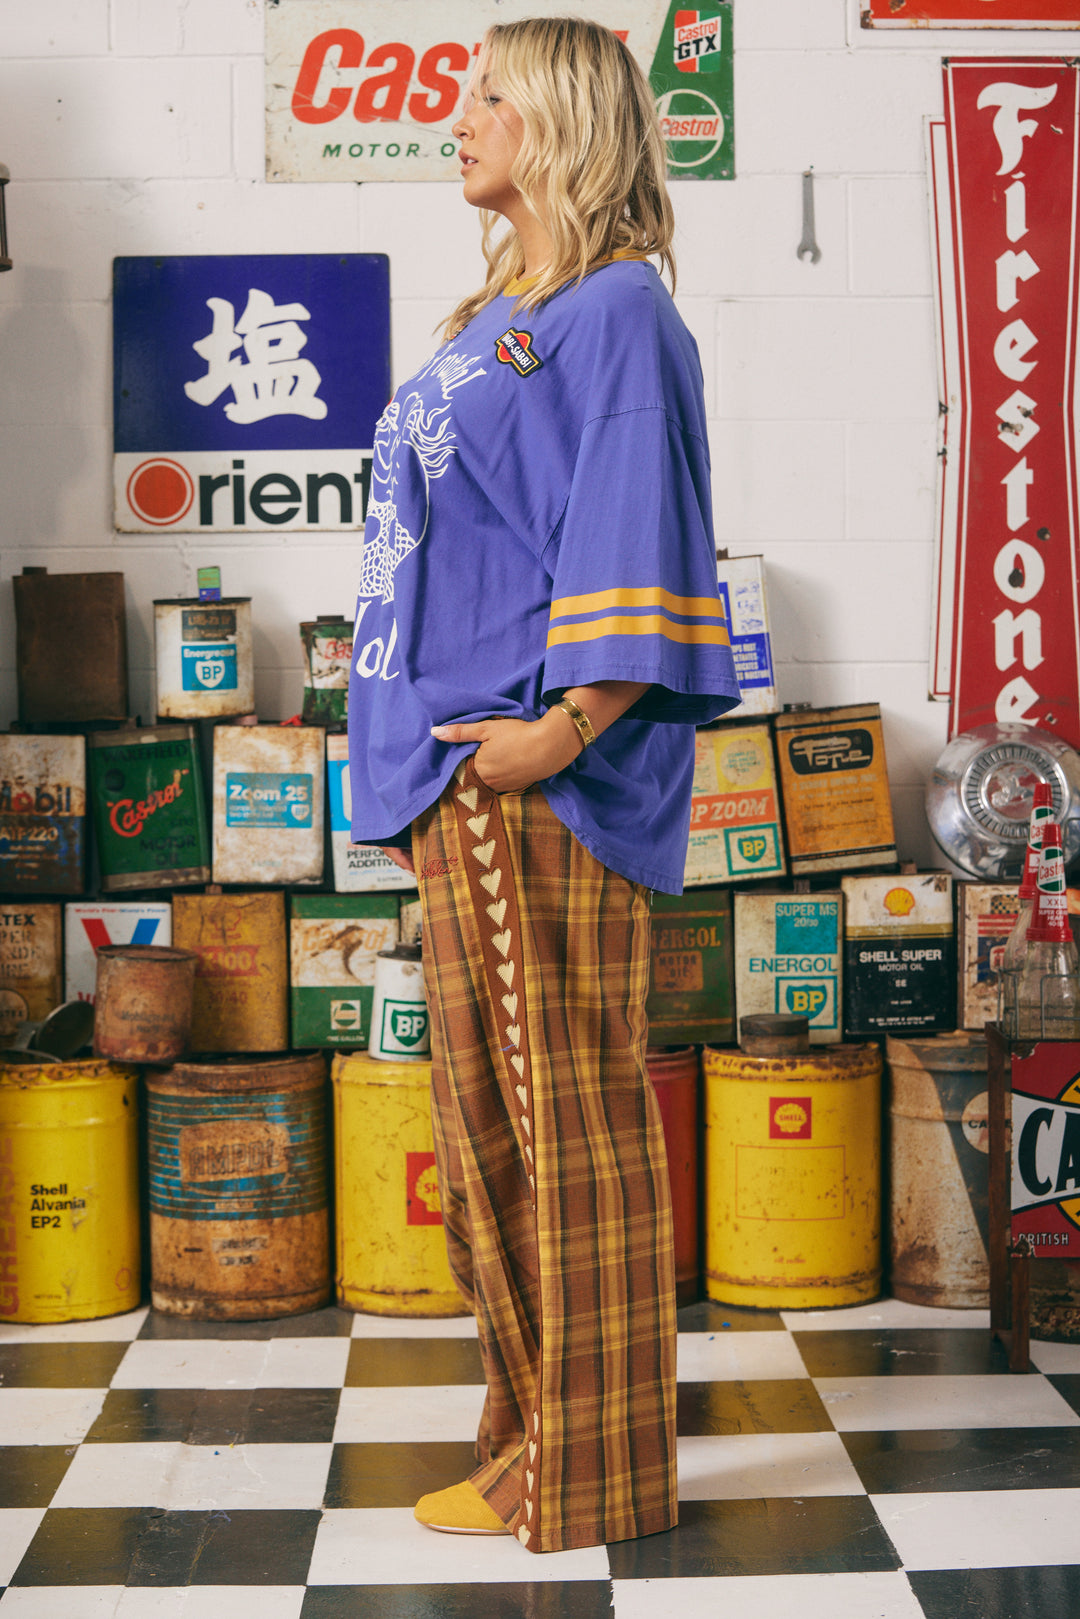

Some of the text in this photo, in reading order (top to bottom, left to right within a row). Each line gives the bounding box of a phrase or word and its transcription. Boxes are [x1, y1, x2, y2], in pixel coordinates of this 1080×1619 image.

[678, 20, 718, 43] Castrol
[678, 34, 717, 60] GTX
[291, 28, 481, 125] Cas
[660, 118, 719, 137] Castrol
[322, 143, 458, 158] MOTOR O
[184, 288, 328, 425] 塩
[976, 82, 1058, 728] Firestone
[324, 641, 354, 660] Cas
[202, 665, 222, 681] BP
[229, 785, 308, 801] Zoom 25
[710, 796, 769, 821] ZOOM
[742, 840, 765, 857] BP
[349, 858, 398, 869] ADDITIV
[776, 903, 838, 917] SUPER MS
[0, 913, 36, 926] TEX
[859, 949, 942, 963] SHELL SUPER
[749, 957, 838, 972] ENERGOL
[878, 963, 924, 972] MOTOR OIL
[792, 990, 825, 1012] BP
[396, 1015, 425, 1038] BP
[779, 1114, 802, 1122] SHELL
[189, 1138, 281, 1178] AMPOL
[1018, 1107, 1080, 1196] CA
[30, 1184, 68, 1196] Shell
[424, 1183, 440, 1194] SH
[30, 1197, 86, 1212] Alvania
[31, 1216, 61, 1229] EP2
